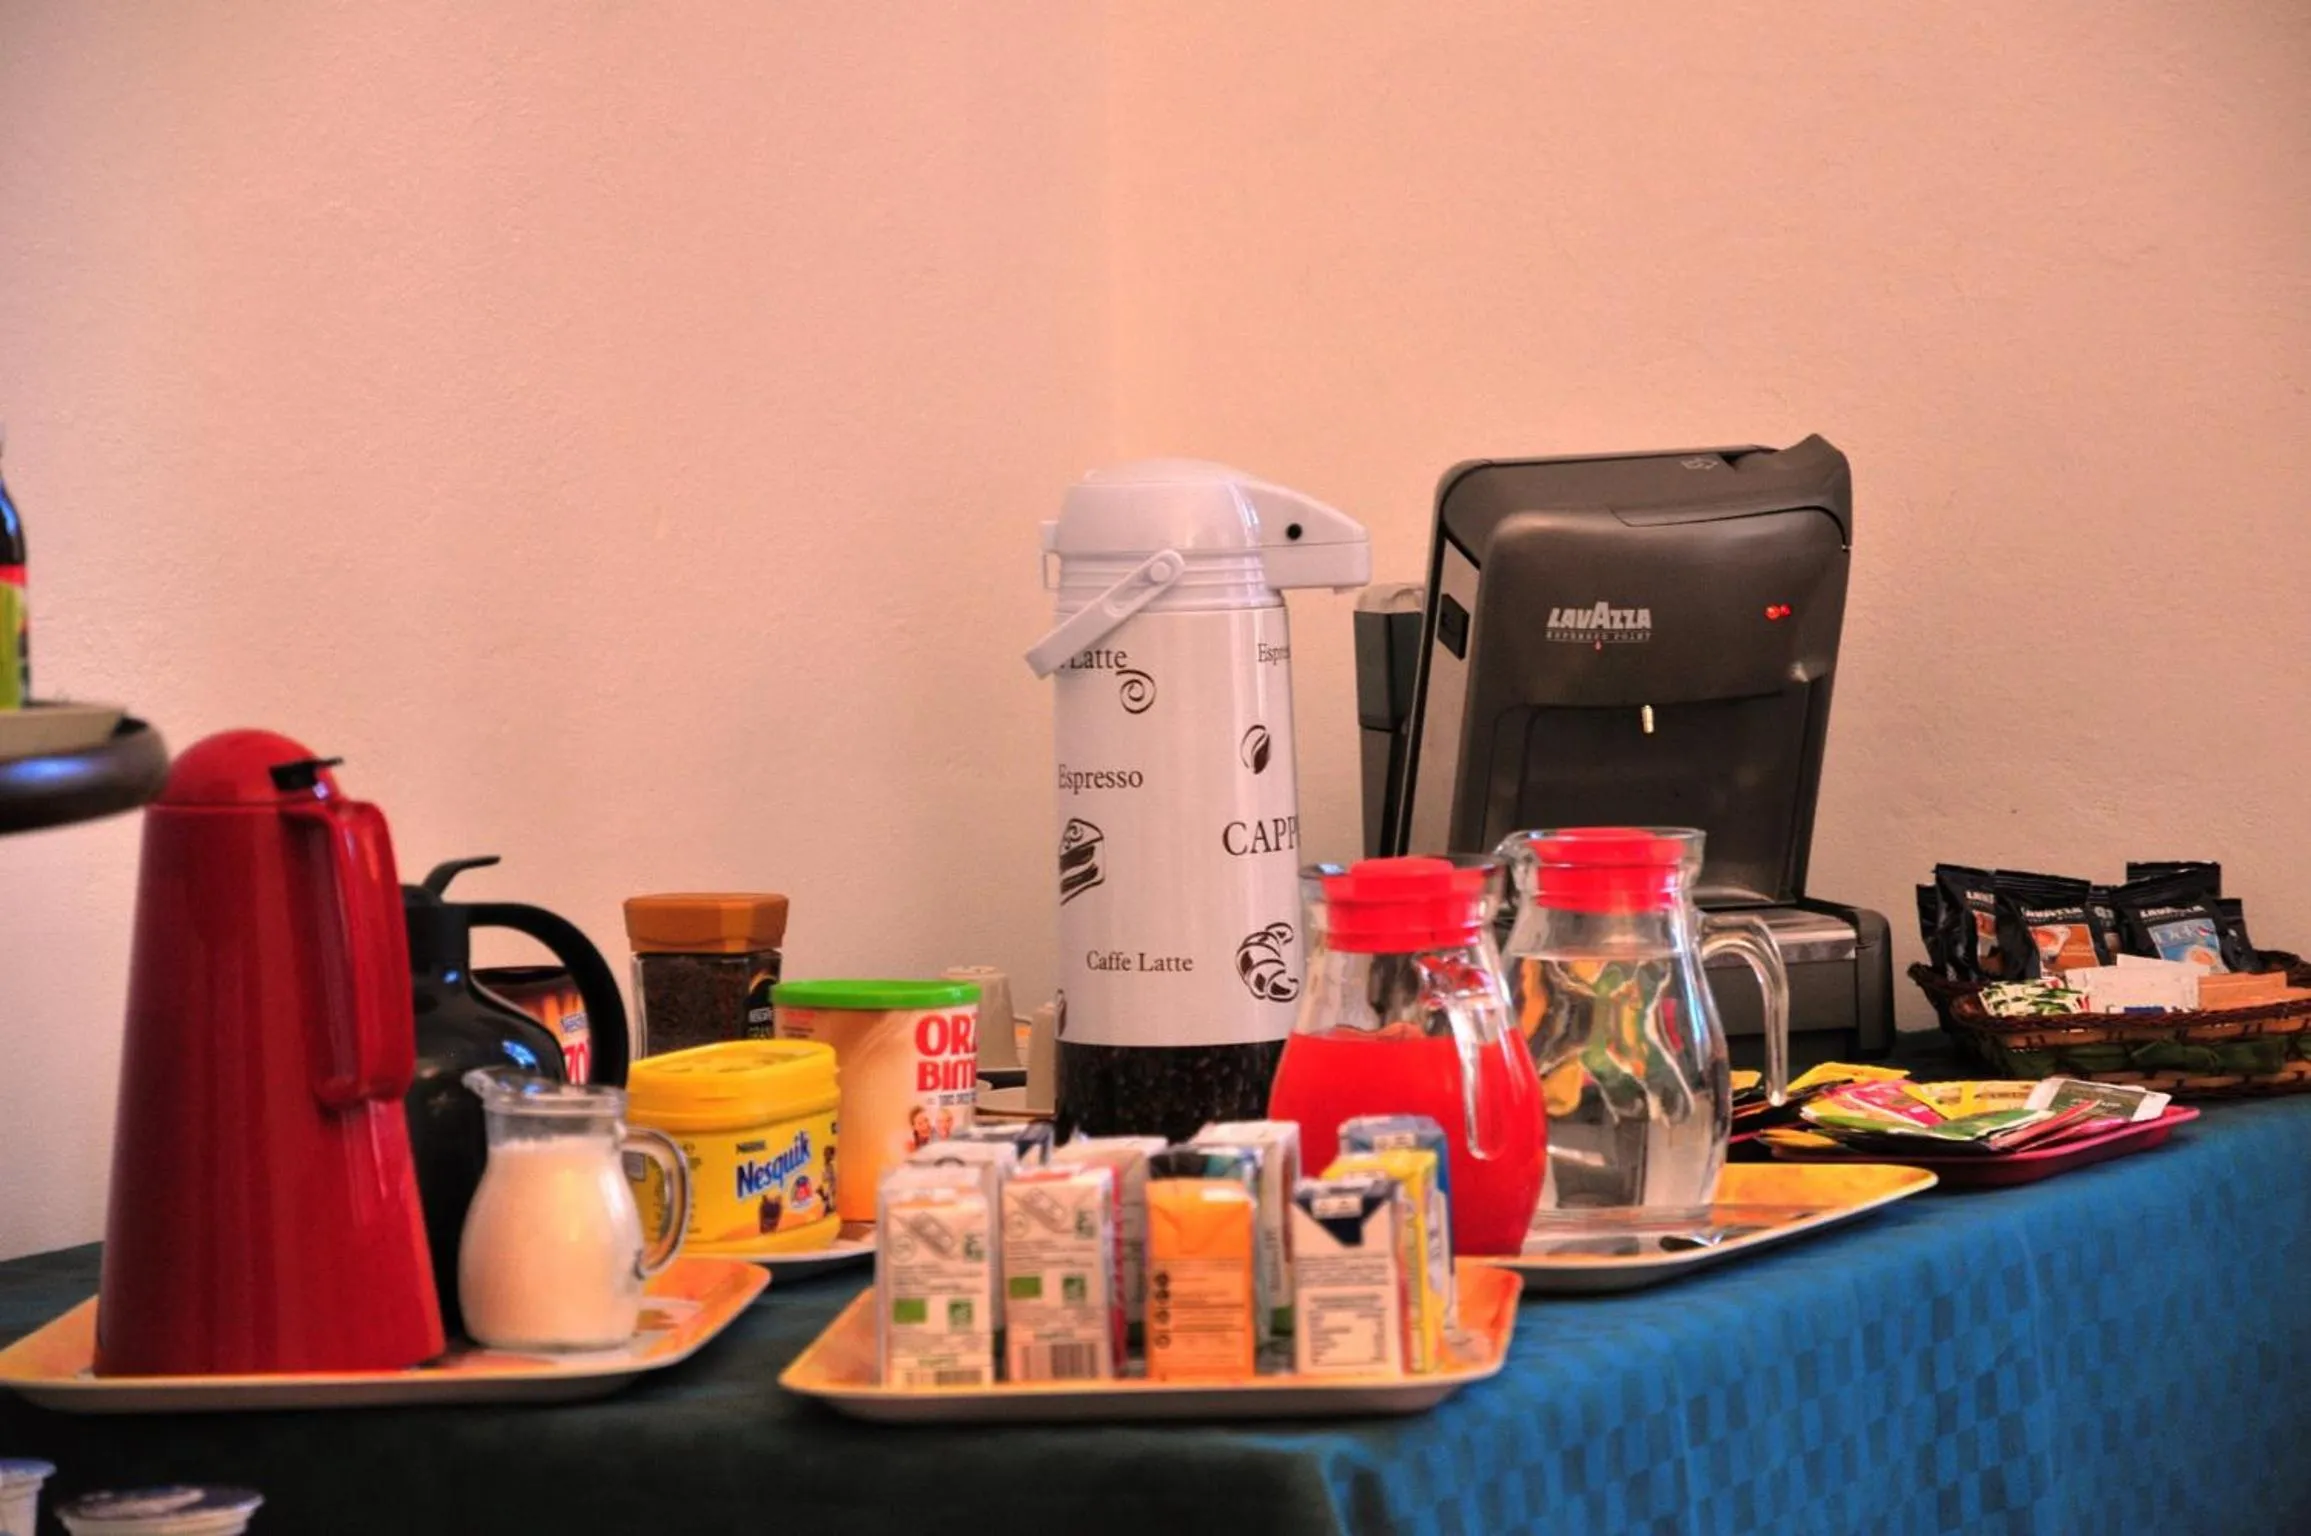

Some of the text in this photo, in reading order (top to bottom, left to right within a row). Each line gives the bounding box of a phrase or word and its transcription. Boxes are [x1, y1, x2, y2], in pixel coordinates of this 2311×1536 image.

[1547, 601, 1652, 630] LAVAZZA
[1058, 763, 1144, 795] Espresso
[1086, 950, 1194, 972] Caffe Latte
[736, 1131, 811, 1200] Nesquik
